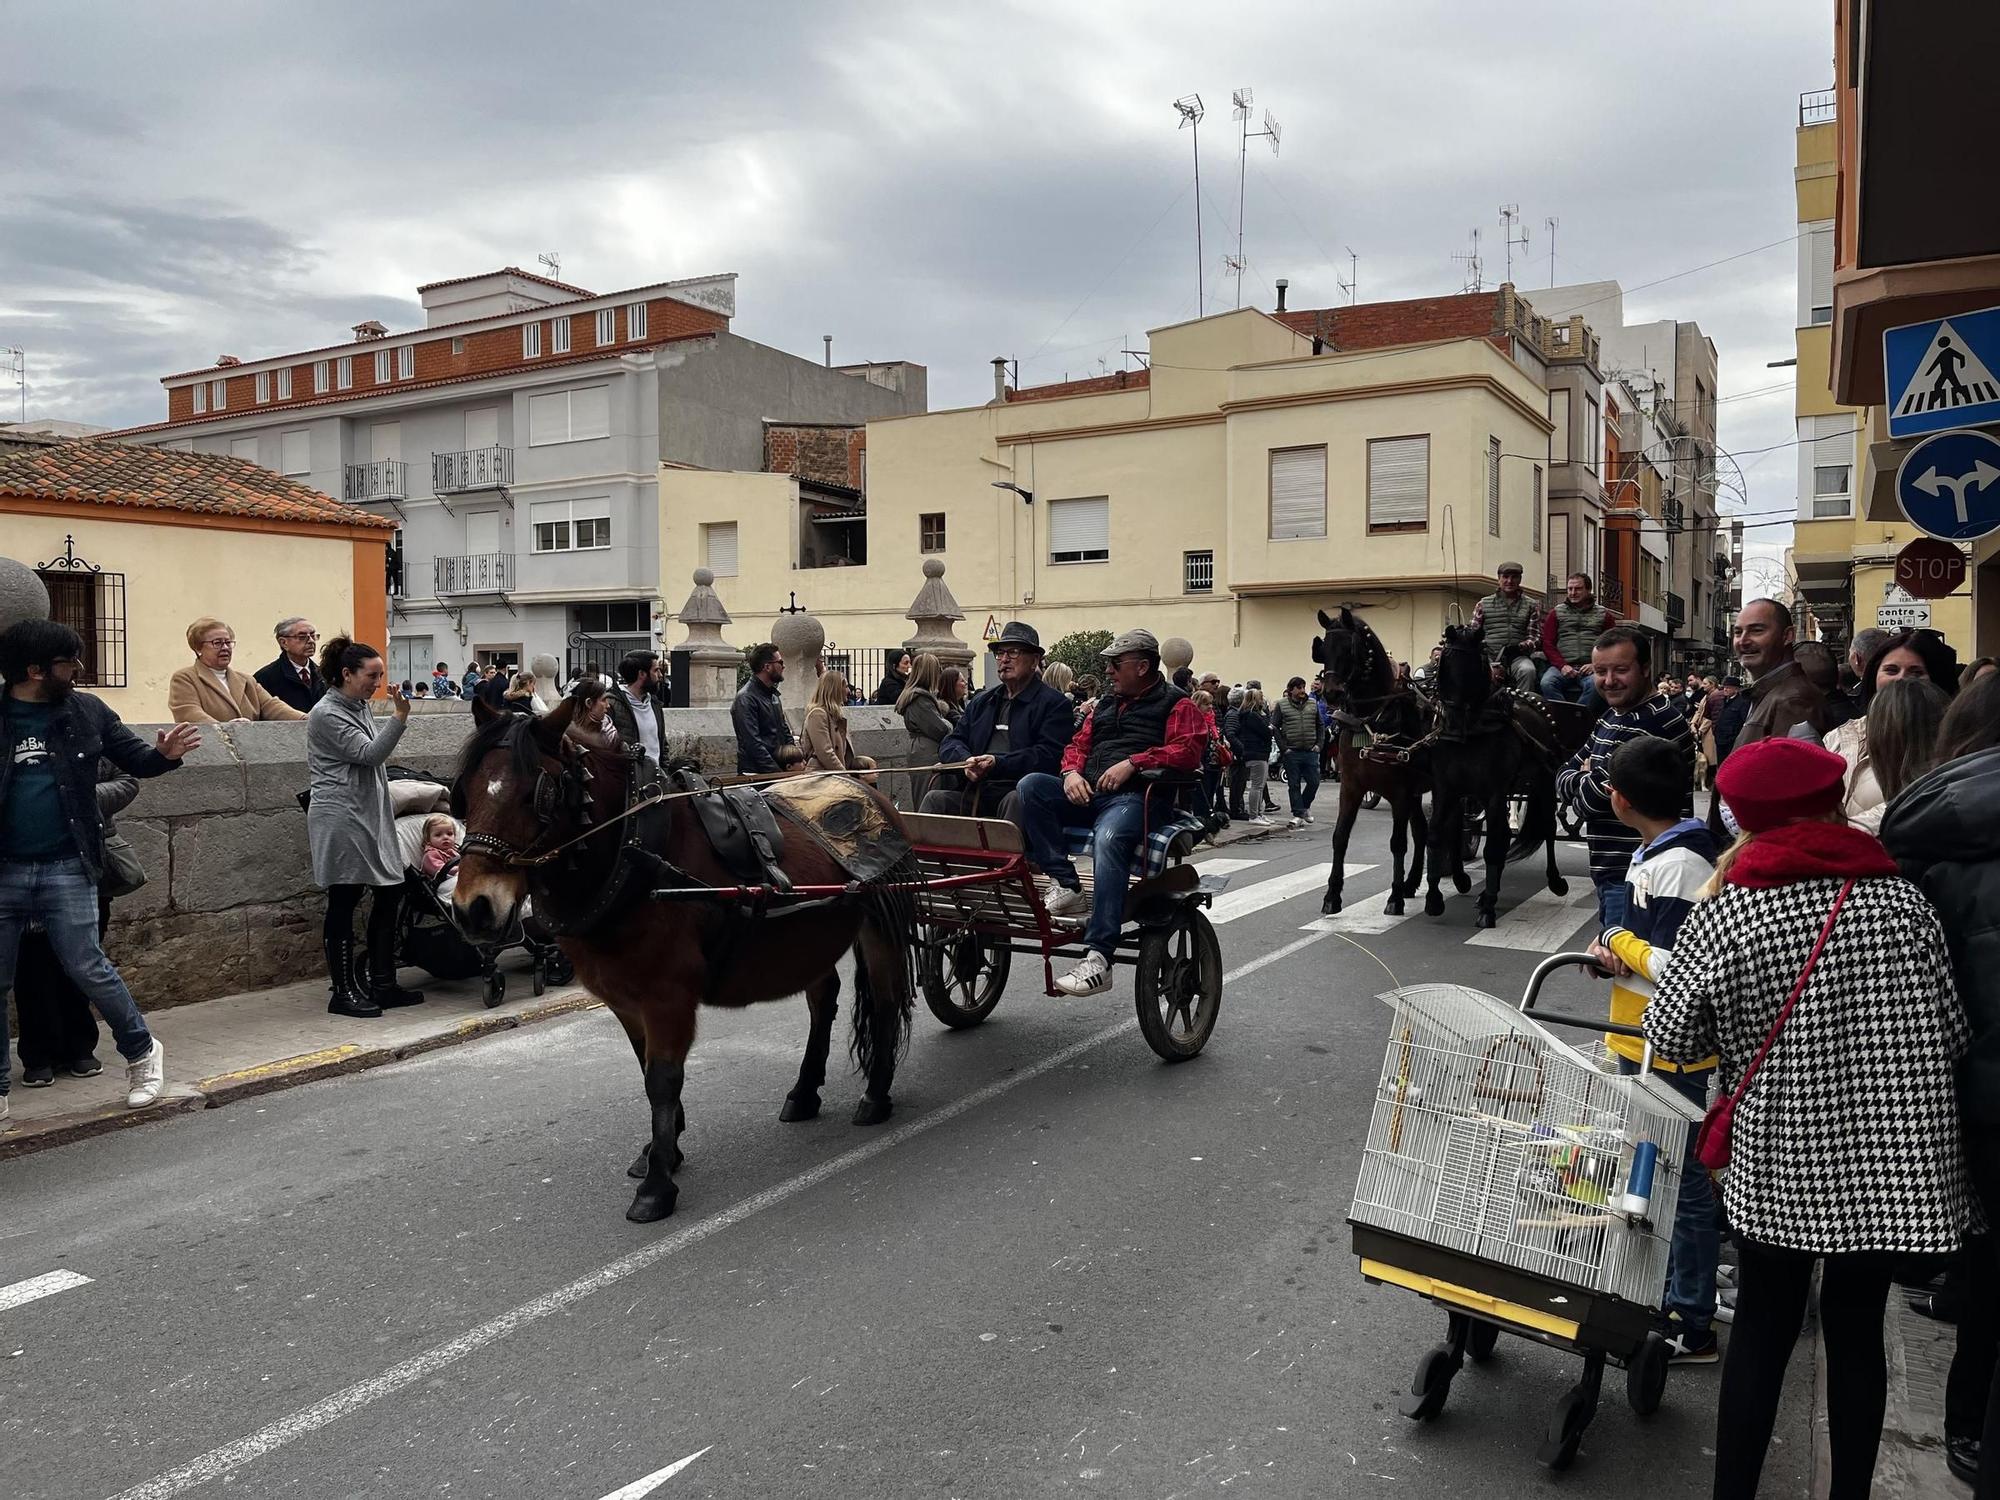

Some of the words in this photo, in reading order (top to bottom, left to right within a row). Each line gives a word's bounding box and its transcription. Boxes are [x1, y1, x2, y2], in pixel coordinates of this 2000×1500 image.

[1900, 558, 1962, 580] STOP
[1878, 608, 1915, 616] centre
[1878, 617, 1903, 626] urbà
